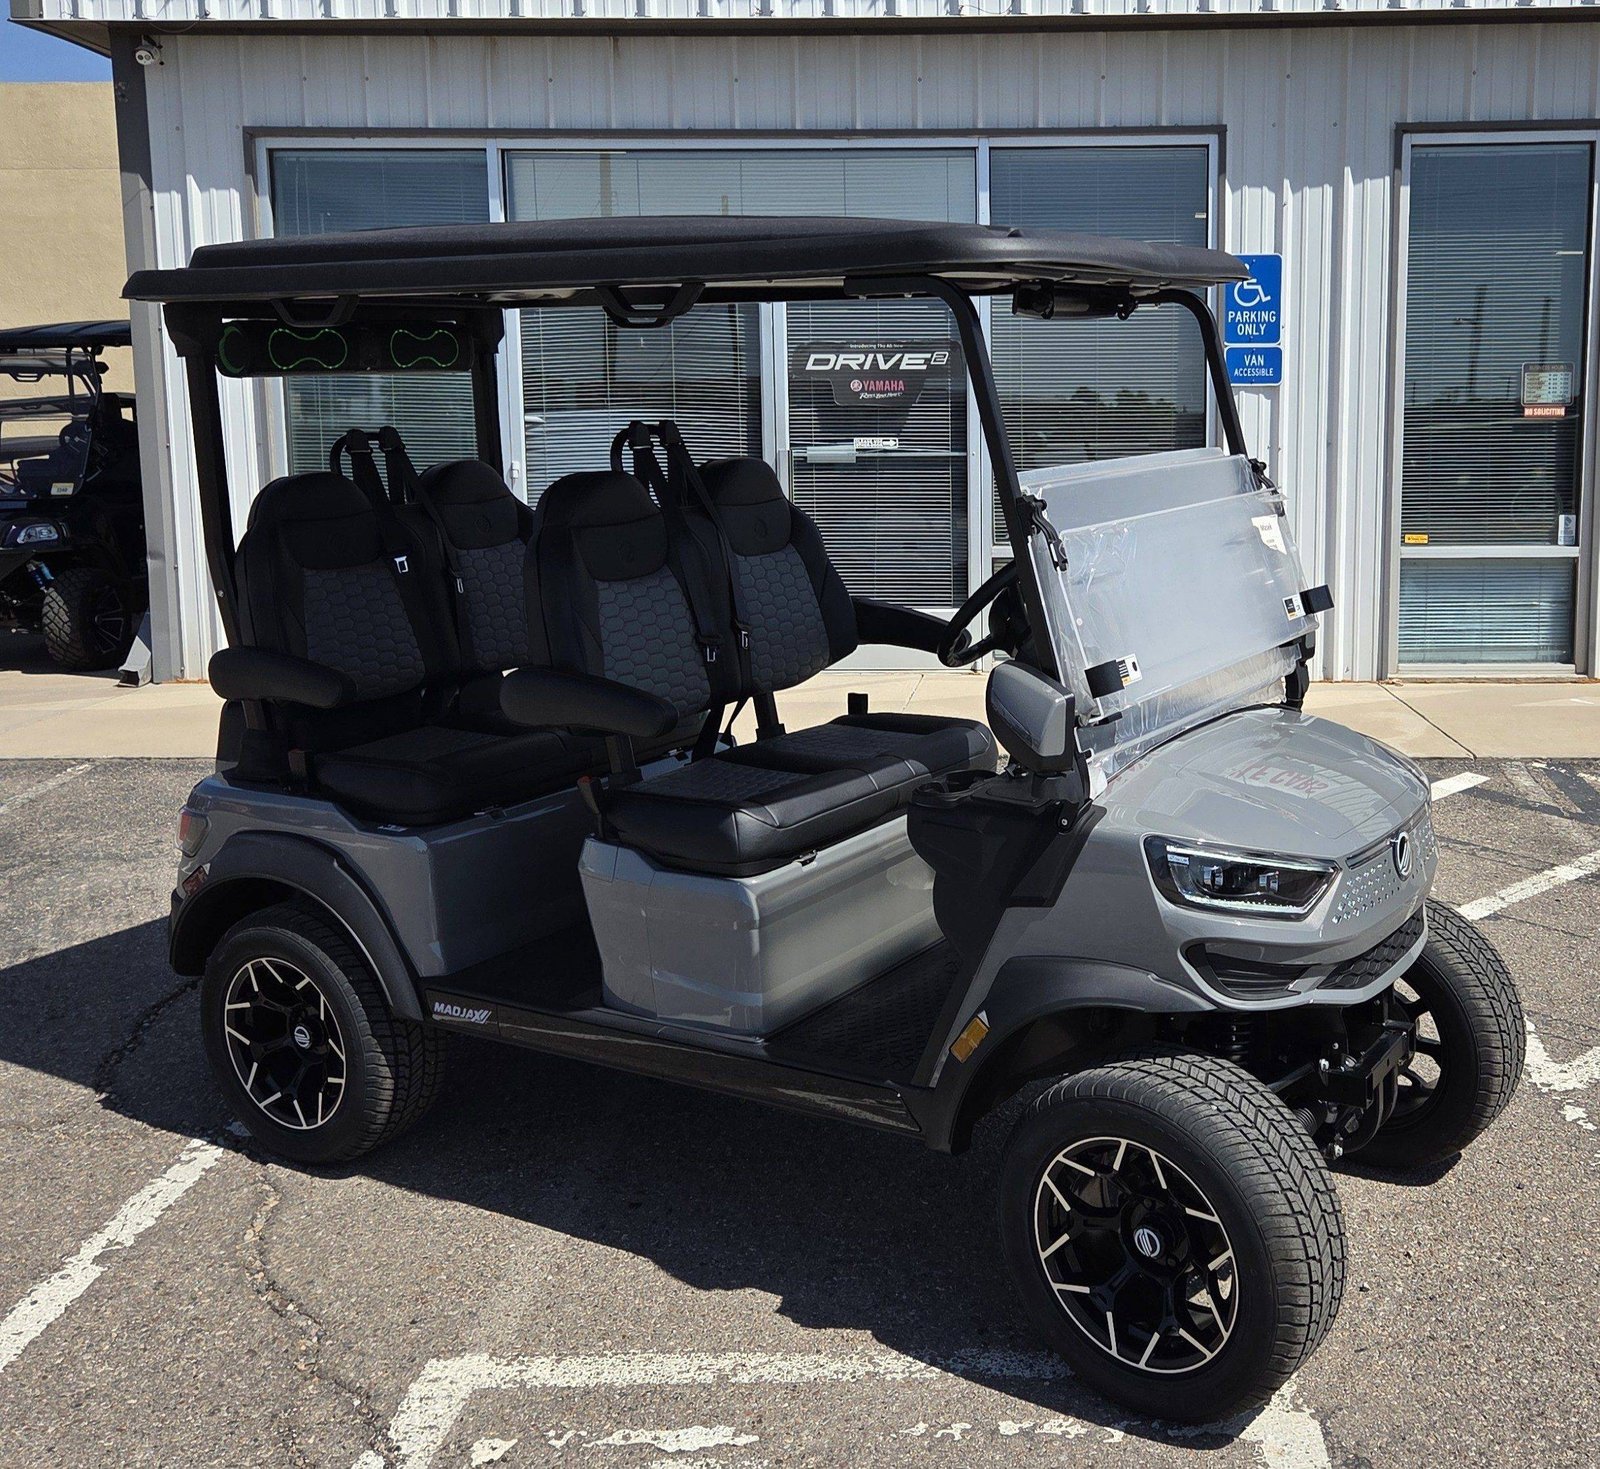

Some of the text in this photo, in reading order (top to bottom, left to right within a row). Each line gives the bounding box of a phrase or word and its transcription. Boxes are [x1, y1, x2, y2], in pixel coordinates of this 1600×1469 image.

[1228, 311, 1276, 322] PARKING
[1237, 323, 1266, 335] ONLY
[1244, 354, 1264, 366] VAN
[1234, 367, 1274, 376] ACCESSIBLE
[863, 380, 905, 391] YAMAHA
[434, 1001, 492, 1024] MADJAX
